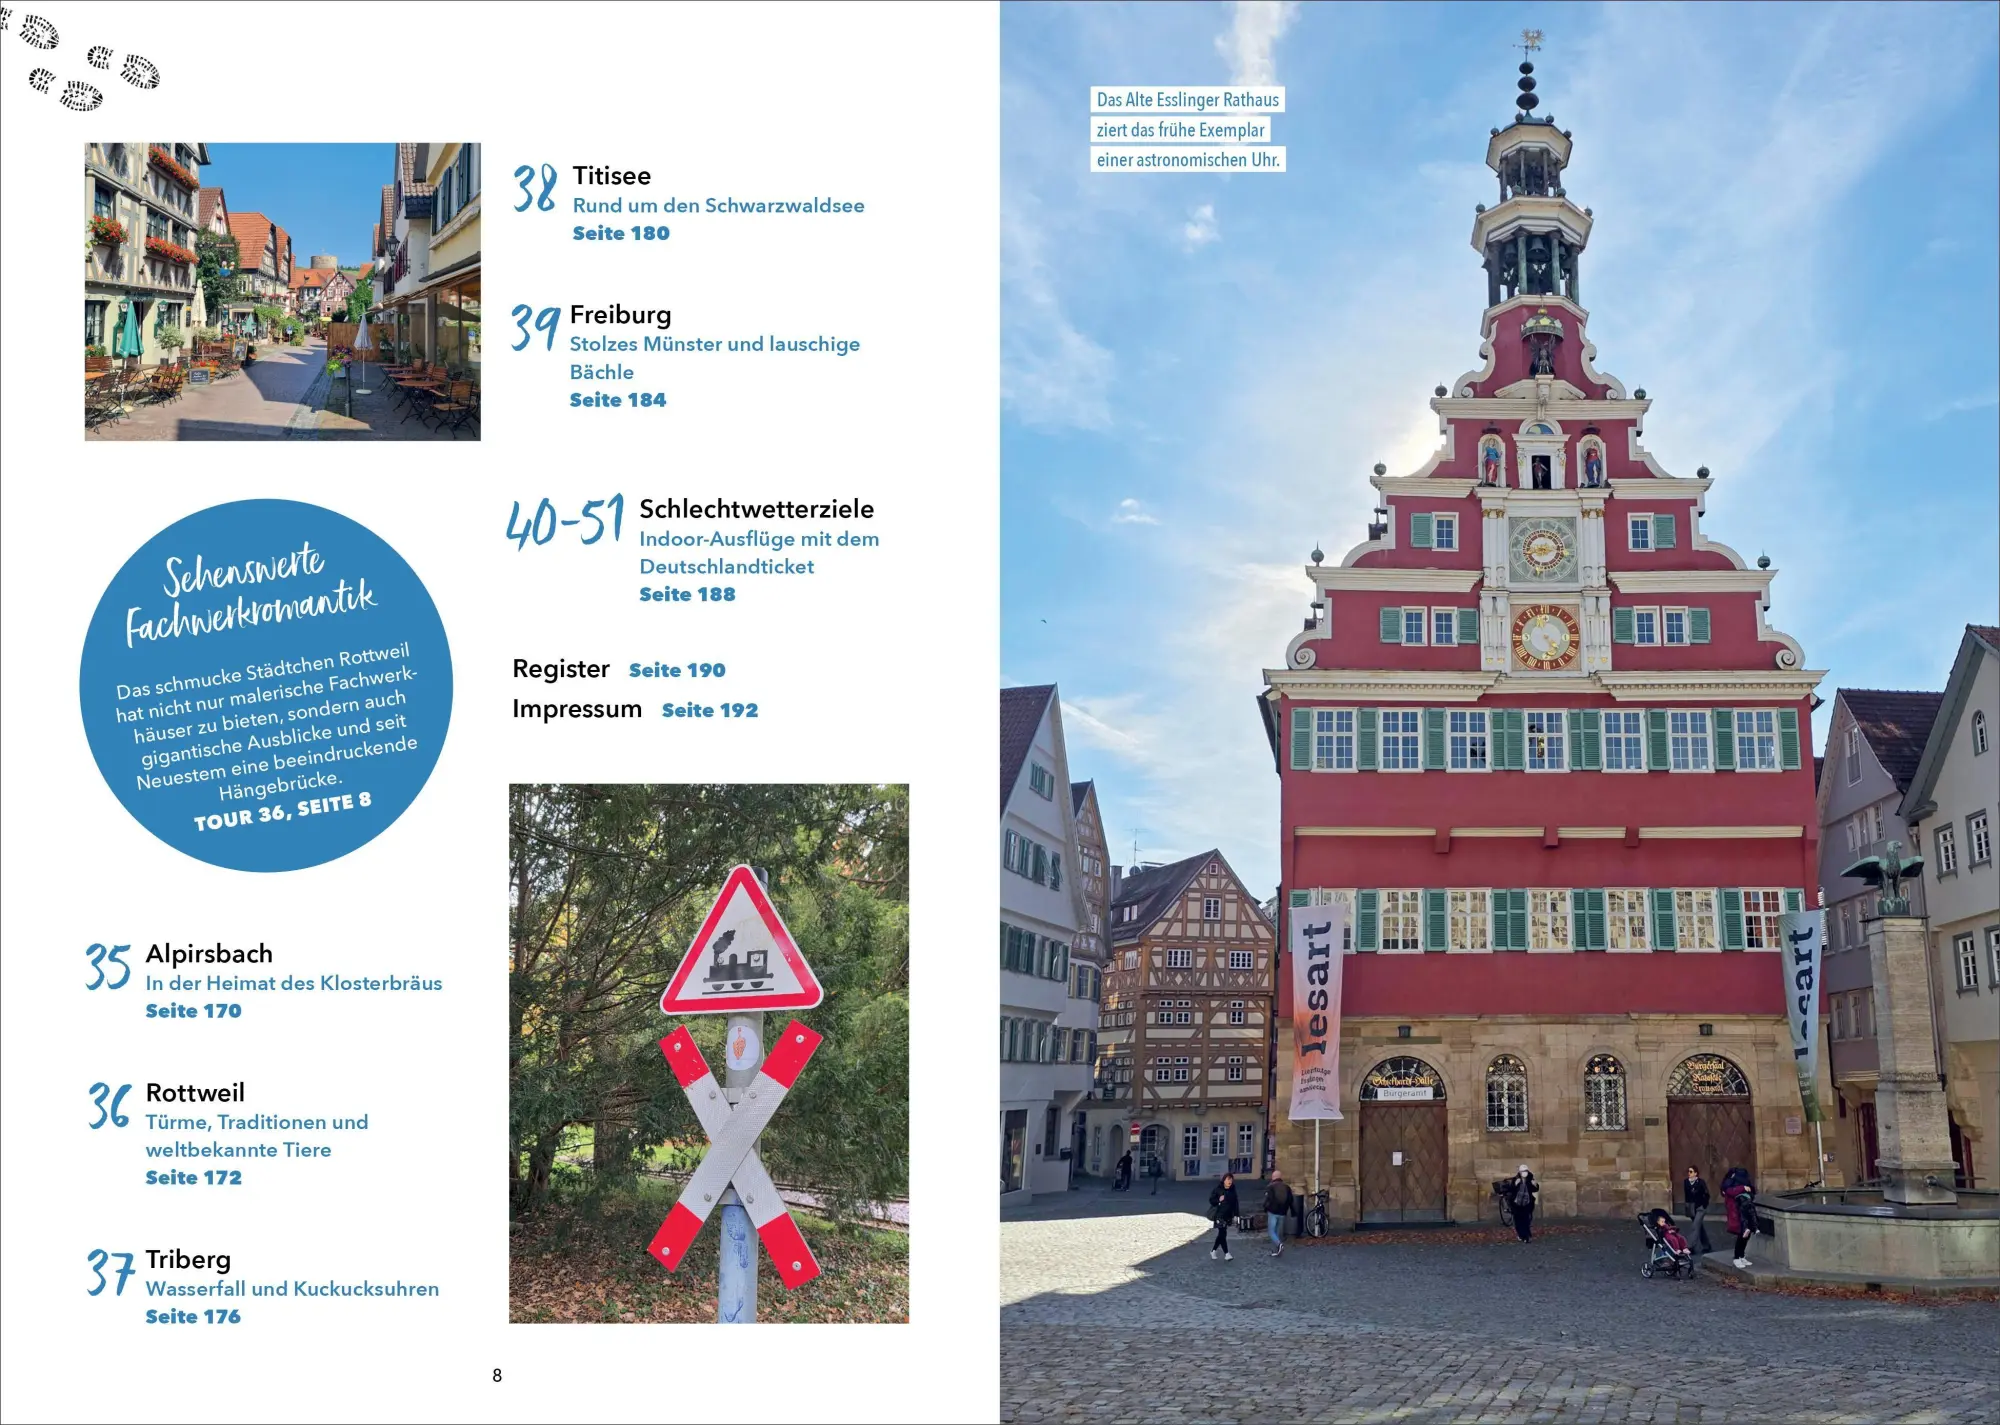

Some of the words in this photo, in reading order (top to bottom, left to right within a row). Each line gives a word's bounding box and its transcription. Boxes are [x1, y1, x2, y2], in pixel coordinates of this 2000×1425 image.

[514, 163, 557, 212] 38
[573, 165, 651, 185] Titisee
[574, 197, 622, 213] Rund
[629, 202, 657, 213] um
[664, 197, 699, 213] den
[706, 197, 864, 213] Schwarzwaldsee
[573, 224, 625, 240] Seite
[631, 225, 670, 240] 180
[512, 304, 561, 351] 39
[571, 303, 671, 330] Freiburg
[570, 335, 637, 351] Stolzes
[644, 335, 722, 351] Münster
[728, 335, 763, 351] und
[770, 335, 860, 356] lauschige
[571, 363, 634, 379] Bächle
[570, 391, 622, 407] Seite
[628, 392, 666, 407] 184
[640, 498, 874, 519] Schlechtwetterziele
[506, 493, 624, 551] 40-51
[640, 530, 795, 551] Indoor-Ausflüge
[802, 530, 832, 546] mit
[837, 530, 879, 546] dem
[163, 540, 326, 599] Sehenswerte
[641, 558, 814, 574] Deutschlandticket
[640, 586, 692, 602] Seite
[698, 587, 736, 602] 188
[126, 577, 378, 649] Fachwerkromantik
[116, 684, 151, 701] Das
[155, 668, 242, 695] schmucke
[246, 656, 335, 681] Städtchen
[339, 641, 410, 667] Rottweil
[514, 658, 610, 684] Register
[629, 661, 681, 678] Seite
[687, 663, 726, 678] 190
[115, 707, 145, 723] hat
[148, 699, 192, 719] nicht
[195, 697, 225, 712] nur
[229, 679, 324, 707] malerische
[328, 664, 418, 692] Fachwerk-
[133, 725, 193, 744] häuser
[197, 721, 218, 735] zu
[221, 712, 284, 731] bieten,
[287, 699, 360, 721] sondern
[364, 688, 406, 710] auch
[514, 699, 641, 724] Impressum
[662, 702, 714, 718] Seite
[720, 703, 758, 718] 192
[141, 738, 243, 771] gigantische
[247, 724, 332, 751] Ausblicke
[337, 717, 371, 737] und
[375, 713, 407, 732] seit
[136, 767, 227, 791] Neuestem
[231, 759, 269, 776] eine
[273, 735, 418, 770] beeindruckende
[219, 771, 343, 801] Hängebrücke.
[193, 809, 254, 832] TOUR
[257, 804, 293, 823] 36,
[297, 793, 354, 817] SEITE
[358, 791, 372, 808] 8
[86, 943, 131, 990] 35
[145, 942, 272, 969] Alpirsbach
[147, 975, 163, 990] In
[169, 975, 201, 990] der
[207, 975, 276, 990] Heimat
[281, 975, 314, 990] des
[321, 974, 442, 990] Klosterbräus
[1302, 921, 1331, 1057] lesart
[146, 1002, 198, 1018] Seite
[204, 1003, 241, 1018] 170
[147, 1082, 244, 1102] Rottweil
[89, 1082, 132, 1129] 36
[145, 1114, 212, 1132] Türme,
[217, 1114, 326, 1129] Traditionen
[333, 1114, 368, 1130] und
[146, 1141, 277, 1157] weltbekannte
[283, 1142, 331, 1157] Tiere
[146, 1169, 198, 1185] Seite
[204, 1170, 242, 1185] 172
[87, 1249, 136, 1296] 37
[145, 1248, 230, 1274] Triberg
[146, 1280, 245, 1296] Wasserfall
[252, 1280, 287, 1296] und
[294, 1280, 439, 1296] Kuckucksuhren
[146, 1308, 198, 1324] Seite
[204, 1309, 241, 1324] 176
[492, 1368, 502, 1382] 8
